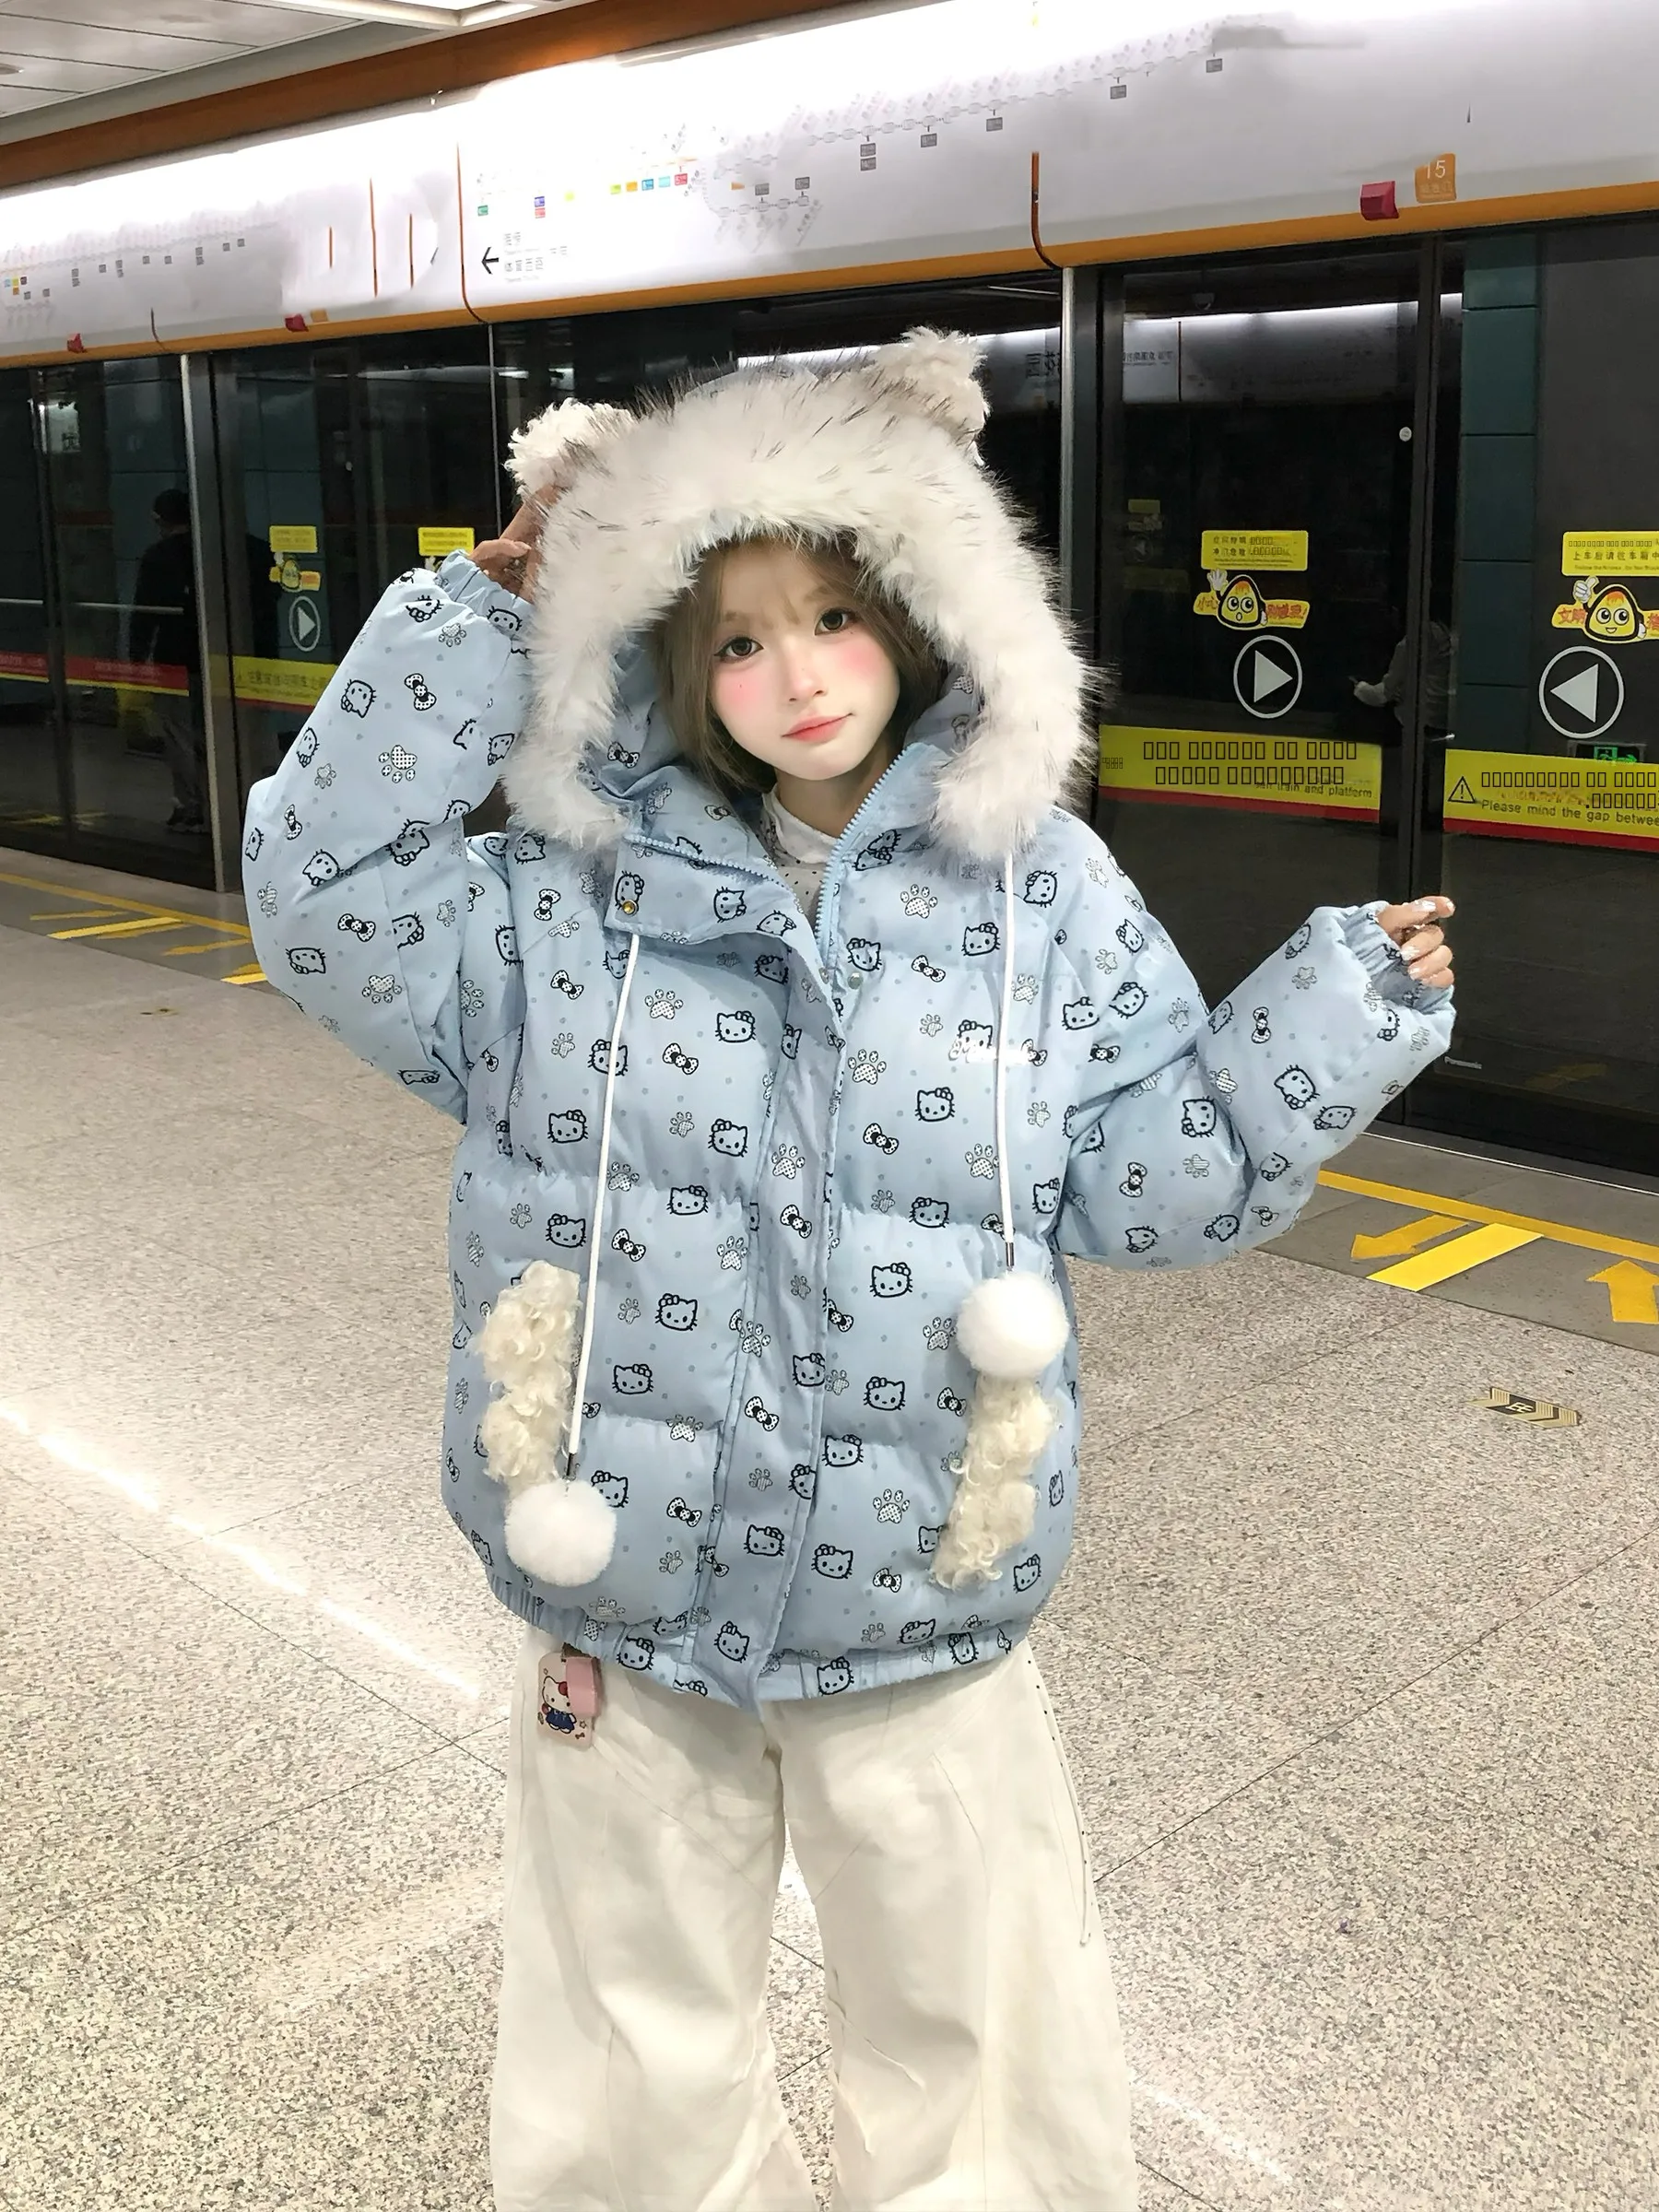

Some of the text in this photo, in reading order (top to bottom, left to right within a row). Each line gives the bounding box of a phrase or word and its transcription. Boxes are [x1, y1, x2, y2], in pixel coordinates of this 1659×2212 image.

[1304, 783, 1324, 795] and
[1328, 784, 1373, 799] platform
[1481, 799, 1522, 814] Please
[1526, 804, 1557, 817] mind
[1561, 806, 1582, 819] the
[1586, 810, 1610, 823] gap
